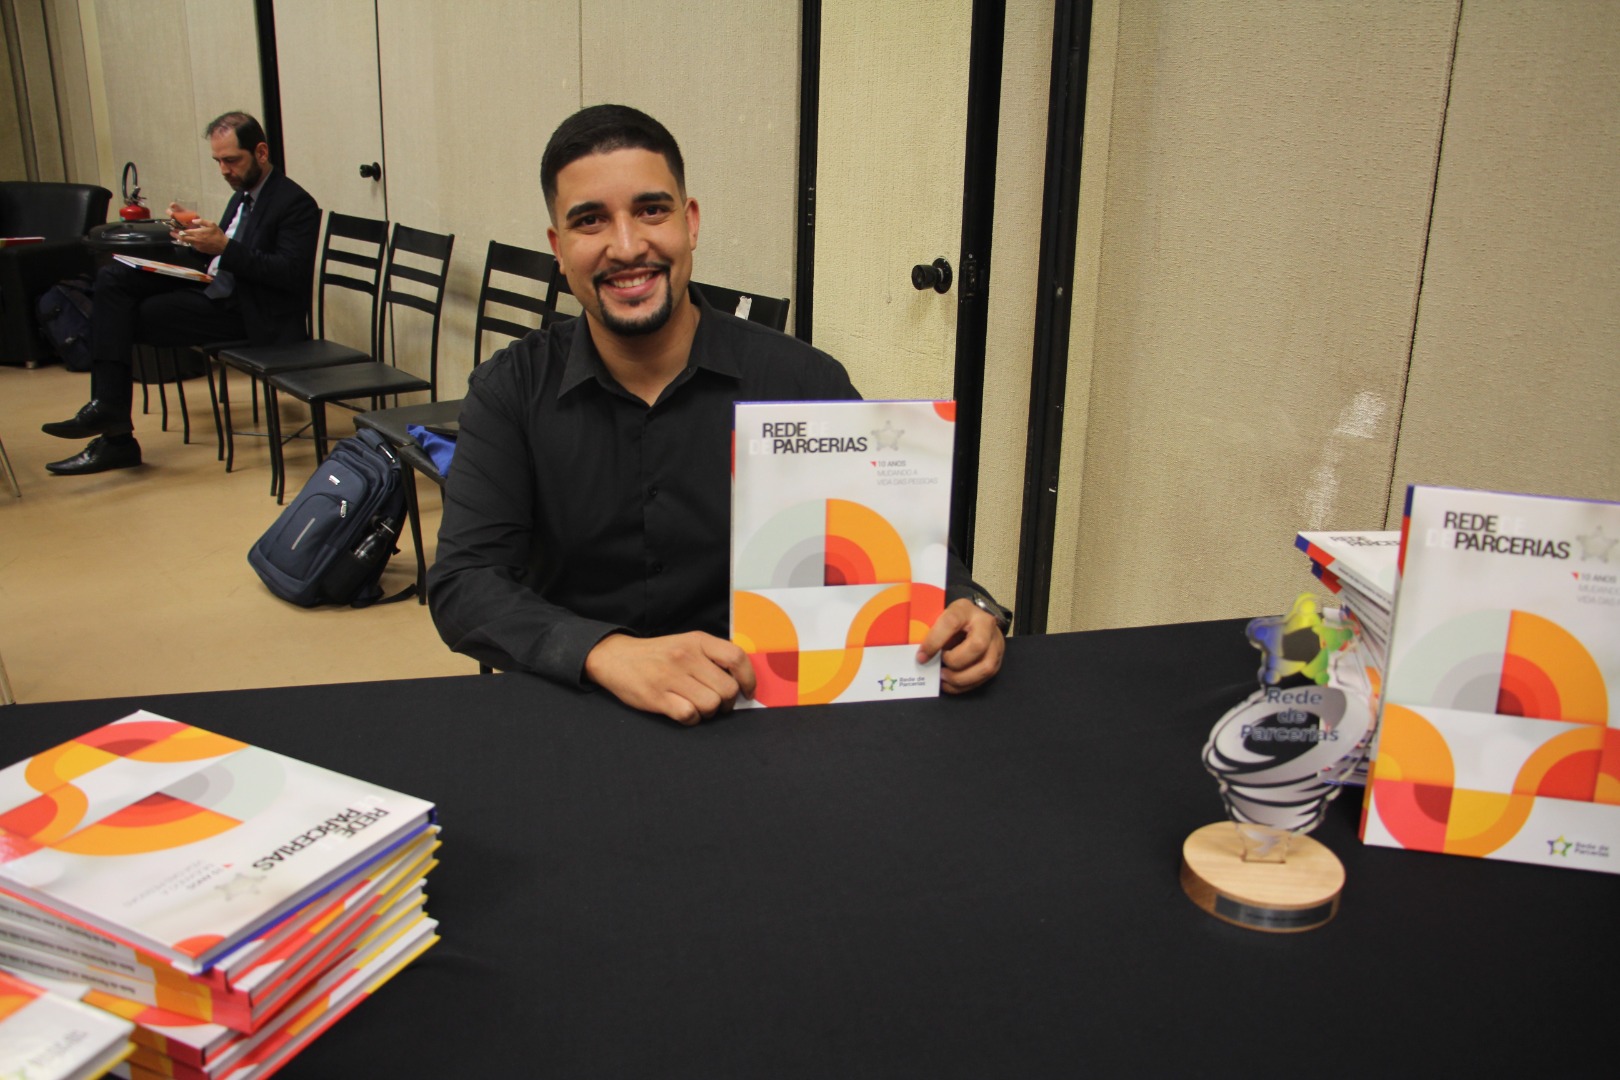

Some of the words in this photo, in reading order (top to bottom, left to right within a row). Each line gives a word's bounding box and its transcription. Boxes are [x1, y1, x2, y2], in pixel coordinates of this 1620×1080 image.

[762, 422, 807, 439] REDE
[773, 437, 868, 455] PARCERIAS
[1443, 511, 1498, 533] REDE
[1454, 531, 1571, 560] PARCERIAS
[1267, 687, 1322, 705] Rede
[1277, 707, 1308, 724] de
[1241, 724, 1339, 742] Parcerias
[334, 807, 390, 839] REDE
[252, 808, 362, 871] PARCERIAS
